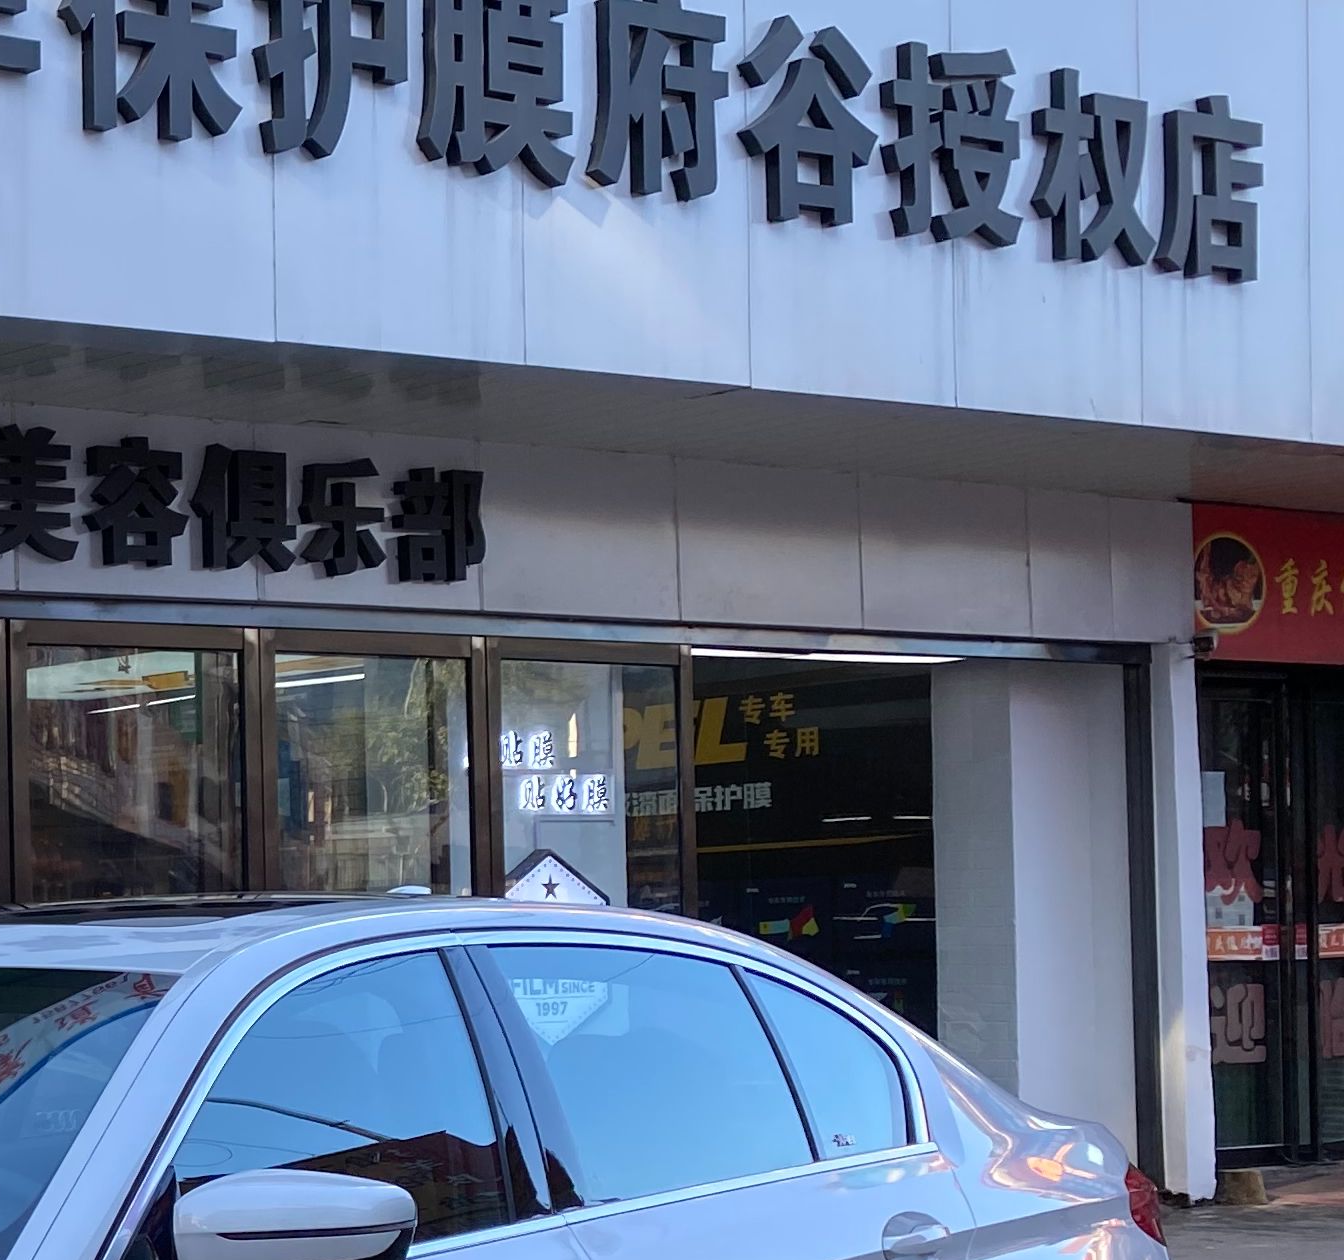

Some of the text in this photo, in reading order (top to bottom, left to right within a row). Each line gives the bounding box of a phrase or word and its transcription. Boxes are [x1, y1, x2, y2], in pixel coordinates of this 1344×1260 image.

[1275, 557, 1344, 617] 重庆
[738, 690, 797, 725] 专车
[762, 726, 823, 760] 专用
[535, 1001, 569, 1016] 1997
